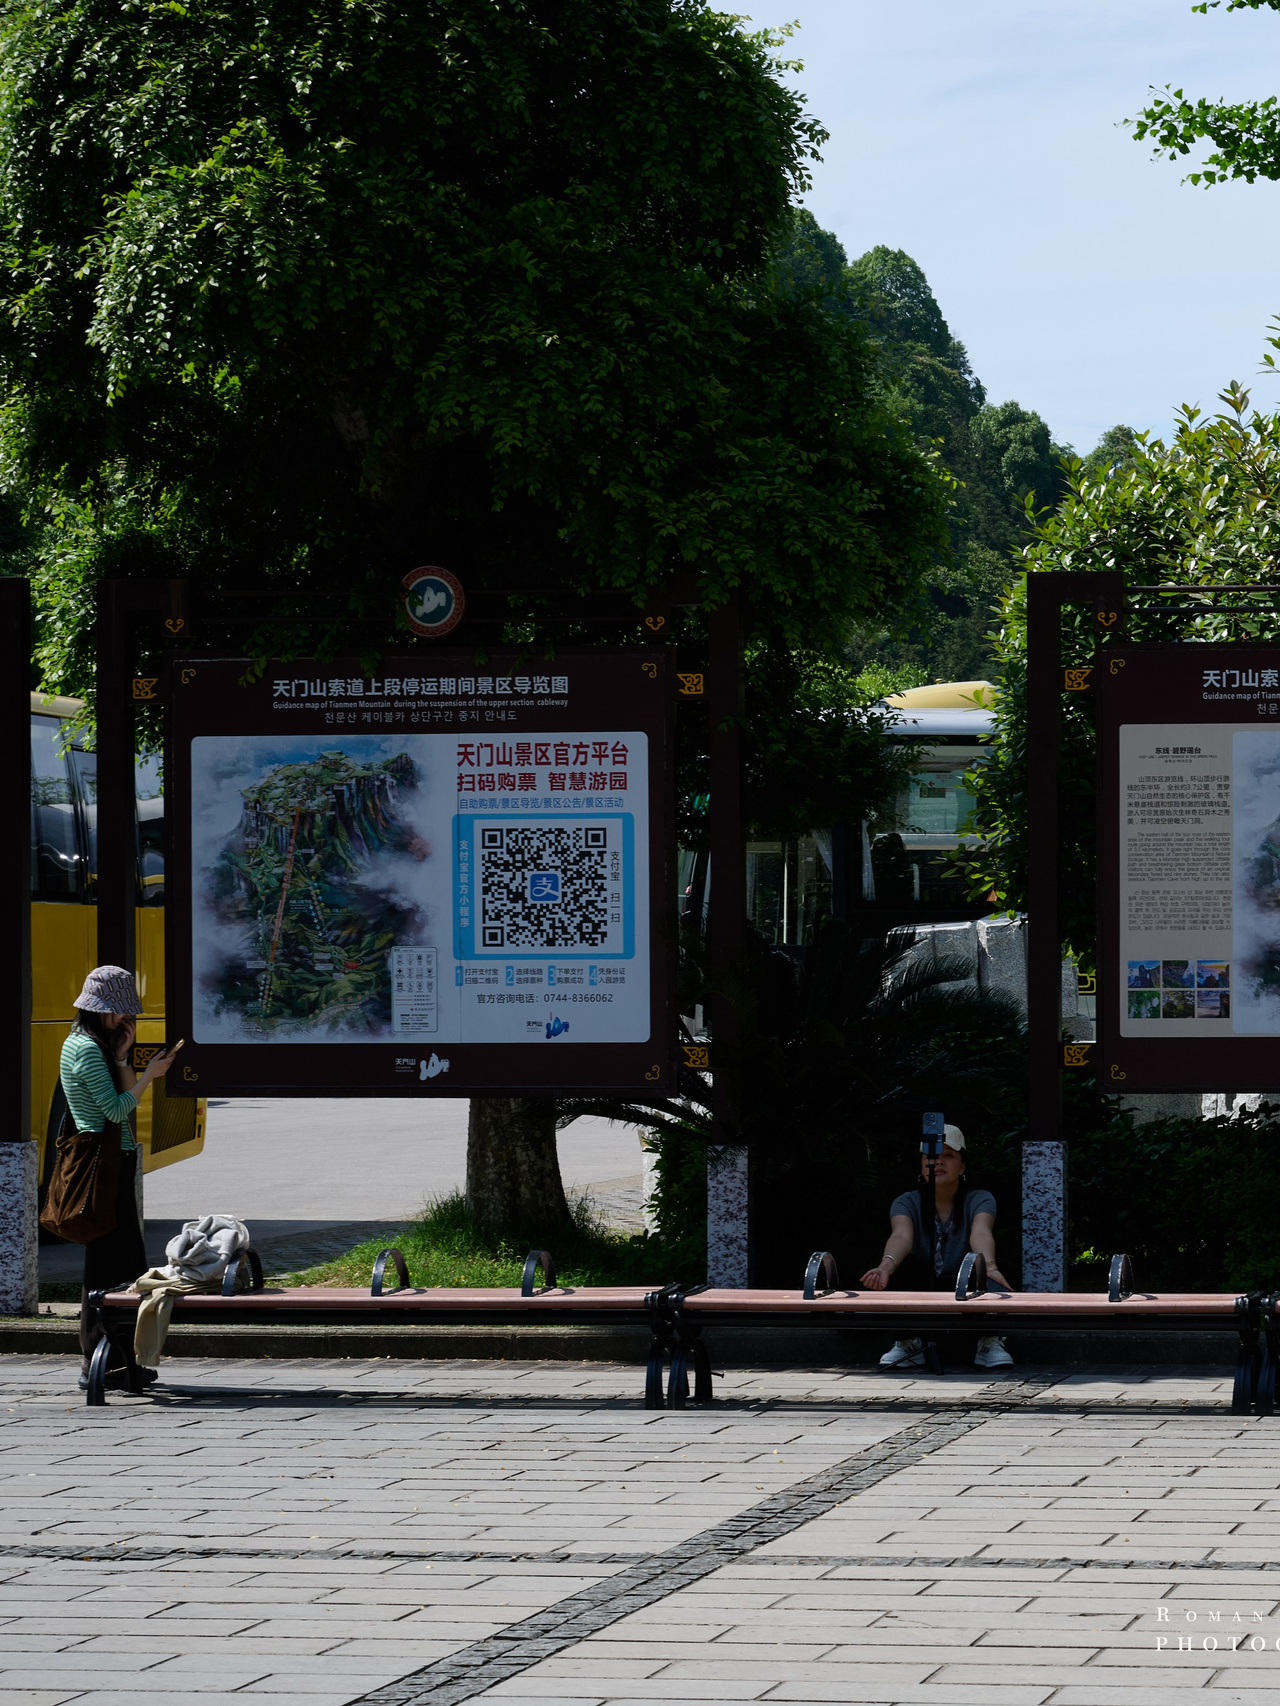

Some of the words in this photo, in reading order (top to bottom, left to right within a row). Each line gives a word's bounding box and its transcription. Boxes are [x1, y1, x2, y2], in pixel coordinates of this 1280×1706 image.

[272, 676, 569, 697] 天门山索道上段停运期间景区导览图
[324, 712, 357, 723] 천문산
[362, 712, 406, 723] 케이블카
[410, 711, 453, 722] 상단구간
[459, 710, 479, 721] 중지
[485, 710, 517, 721] 안내도
[457, 741, 629, 767] 天门山景区官方平台
[457, 772, 536, 792] 扫码购票
[548, 772, 627, 791] 智慧游园
[460, 797, 623, 809] 自助购票/景区导览/景区公告/景区活动
[610, 851, 620, 881] 支付宝
[459, 840, 469, 928] 支付宝官方小程序
[610, 892, 620, 922] 扫一扫
[506, 968, 513, 984] 2
[549, 968, 556, 984] 3
[590, 968, 597, 985] 4
